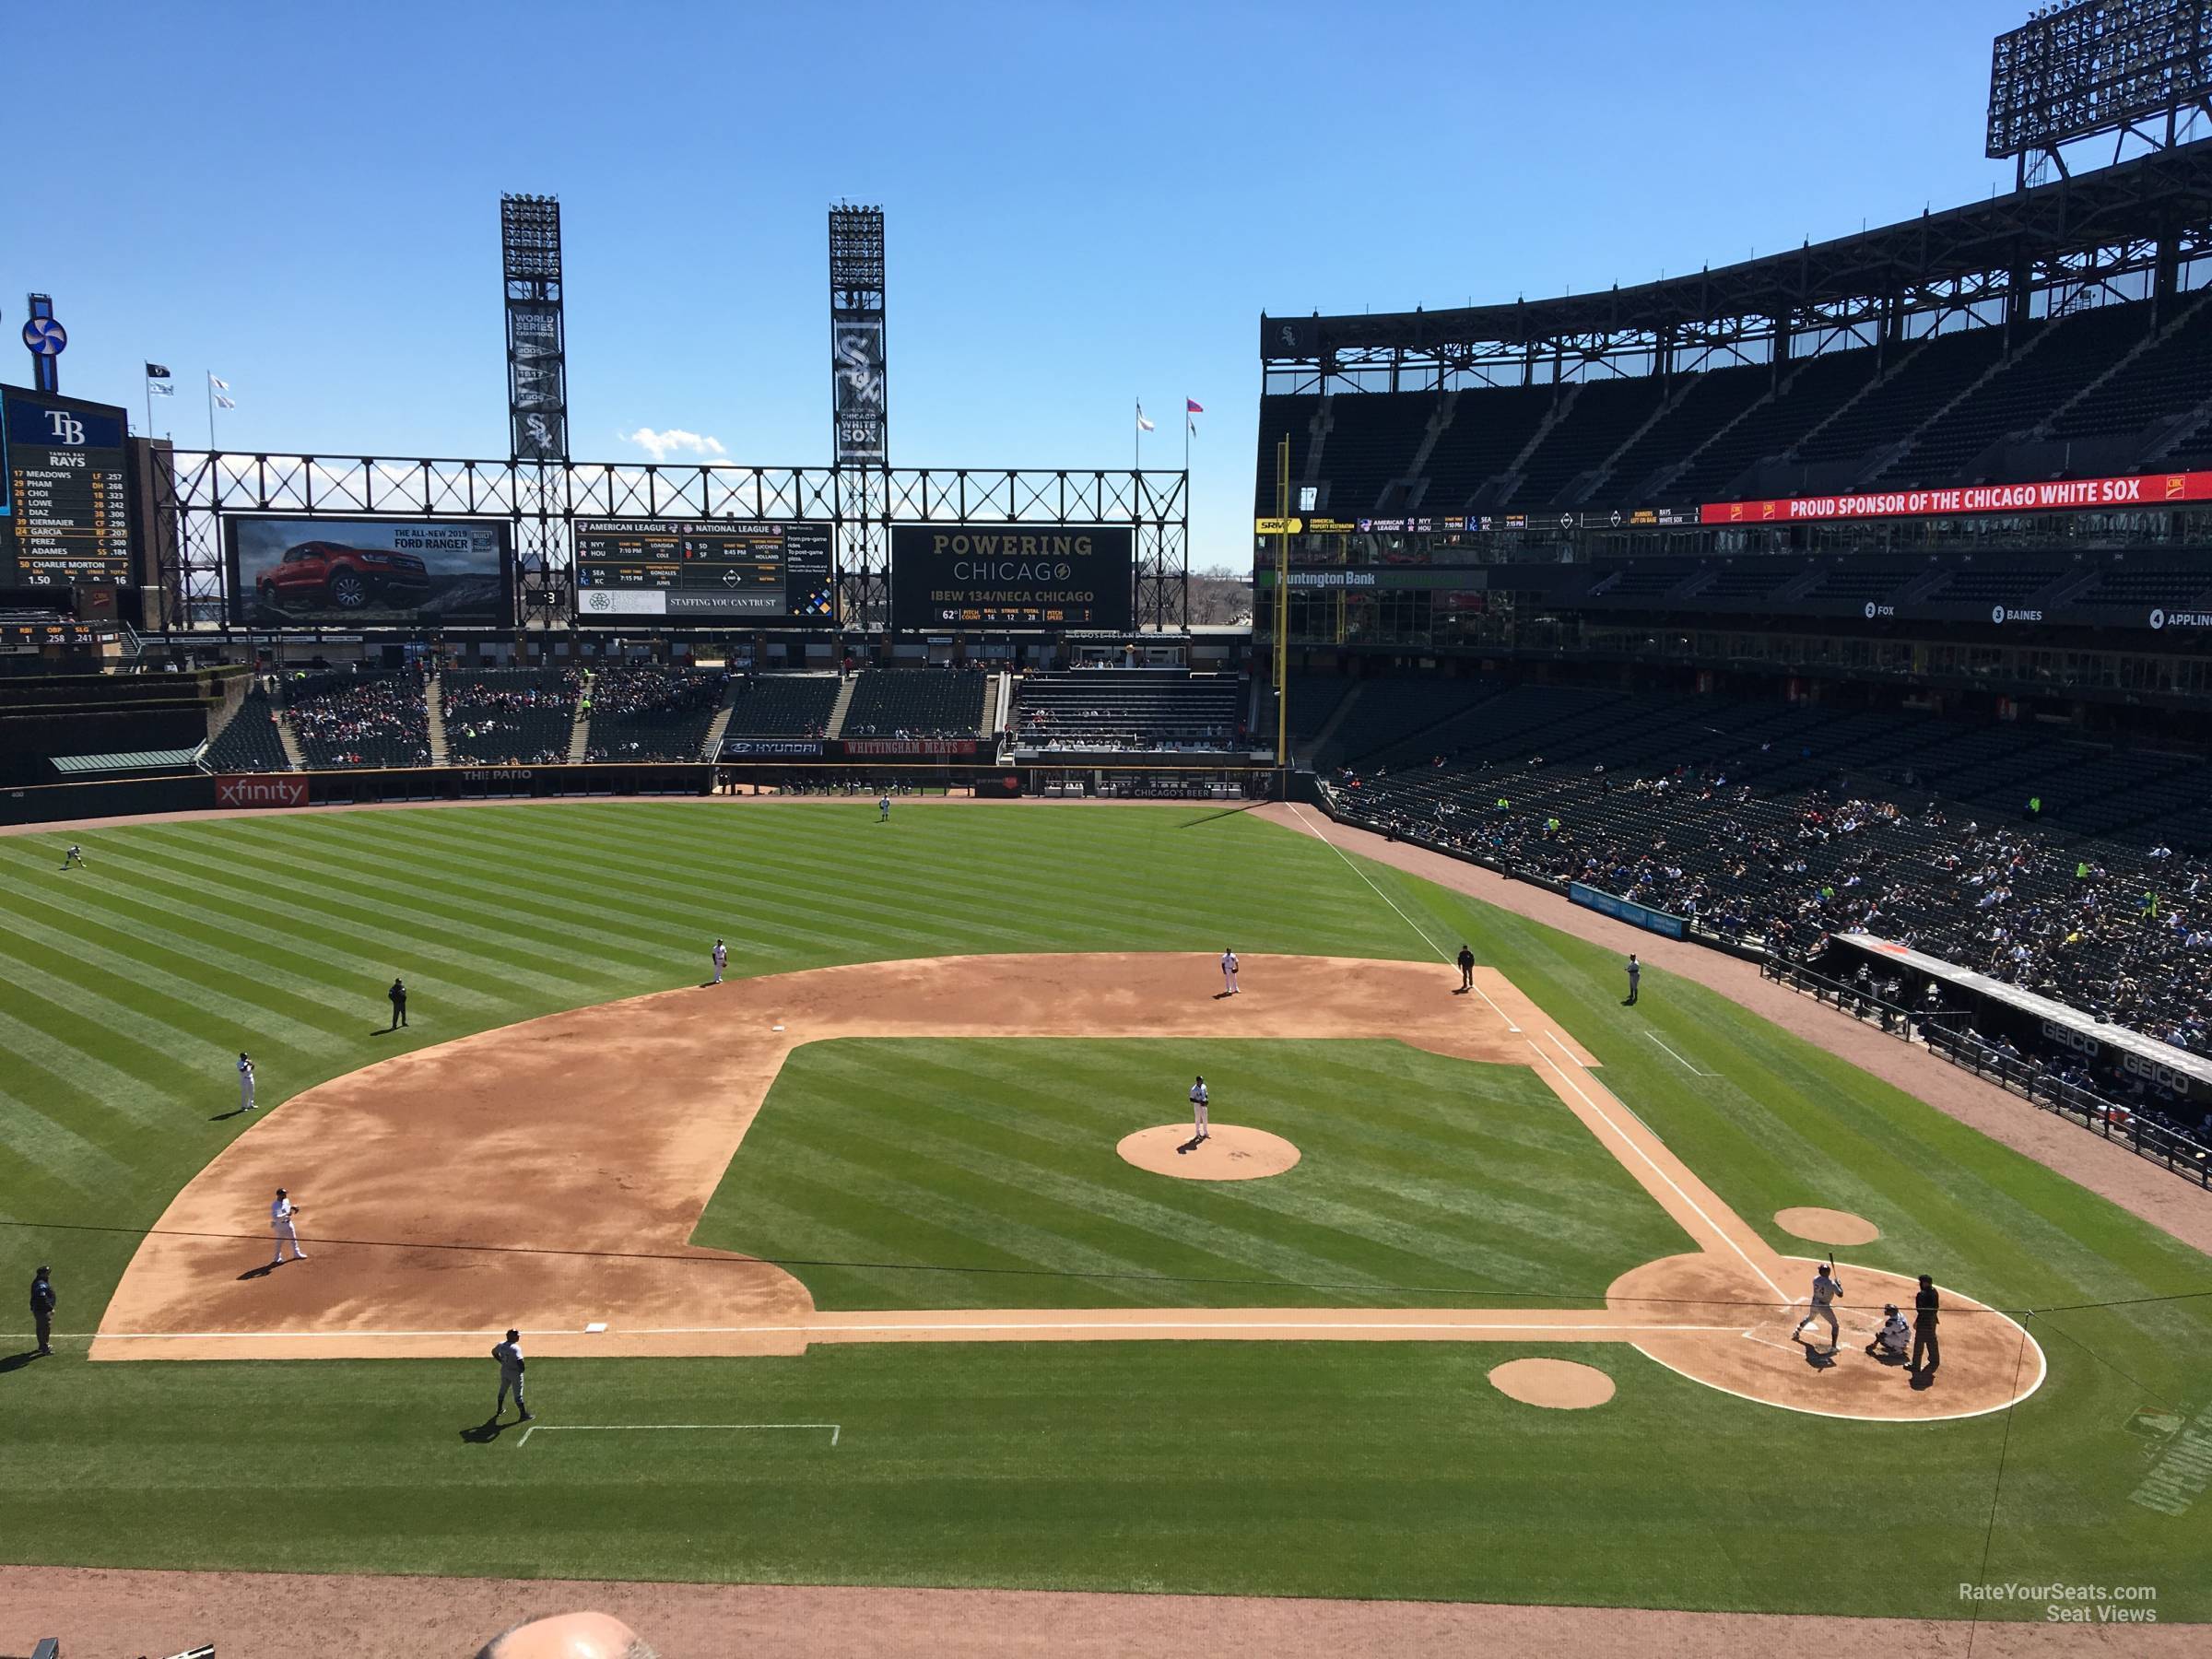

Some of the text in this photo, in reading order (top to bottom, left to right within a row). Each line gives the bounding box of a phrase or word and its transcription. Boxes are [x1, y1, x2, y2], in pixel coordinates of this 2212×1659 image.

[515, 314, 554, 323] WORLD
[516, 323, 554, 332] SERIES
[44, 410, 86, 444] TB
[841, 420, 876, 429] WHITE
[841, 429, 876, 442] SOX
[50, 456, 86, 467] RAYS
[26, 471, 72, 479] MEADOWS
[1790, 479, 2141, 517] PROUD SPONSOR OF THE CHICAGO WHITE SOX
[394, 529, 409, 537] THE
[696, 524, 737, 533] NATIONAL
[394, 538, 468, 549] FORD RANGER
[933, 535, 1092, 556] POWERING
[954, 561, 1071, 581] CHICAGO
[28, 576, 126, 584] 1.50 16
[1346, 571, 1375, 585] Bank
[931, 591, 1094, 602] IBEW 134/NECA CHICAGO
[1877, 606, 1895, 617] FOX
[2006, 609, 2042, 621] BAINES
[25, 635, 30, 643] 1
[75, 634, 92, 642] .241
[756, 743, 817, 753] HYUNDAI
[848, 742, 921, 754] WHITTINGHAM
[924, 742, 959, 754] MEATS
[462, 770, 532, 781] THE PATIO
[221, 779, 303, 806] xfinity
[1135, 788, 1209, 798] CHICAGO'S BEER
[2042, 1020, 2099, 1057] GEICO
[2123, 1053, 2189, 1094] GEICO
